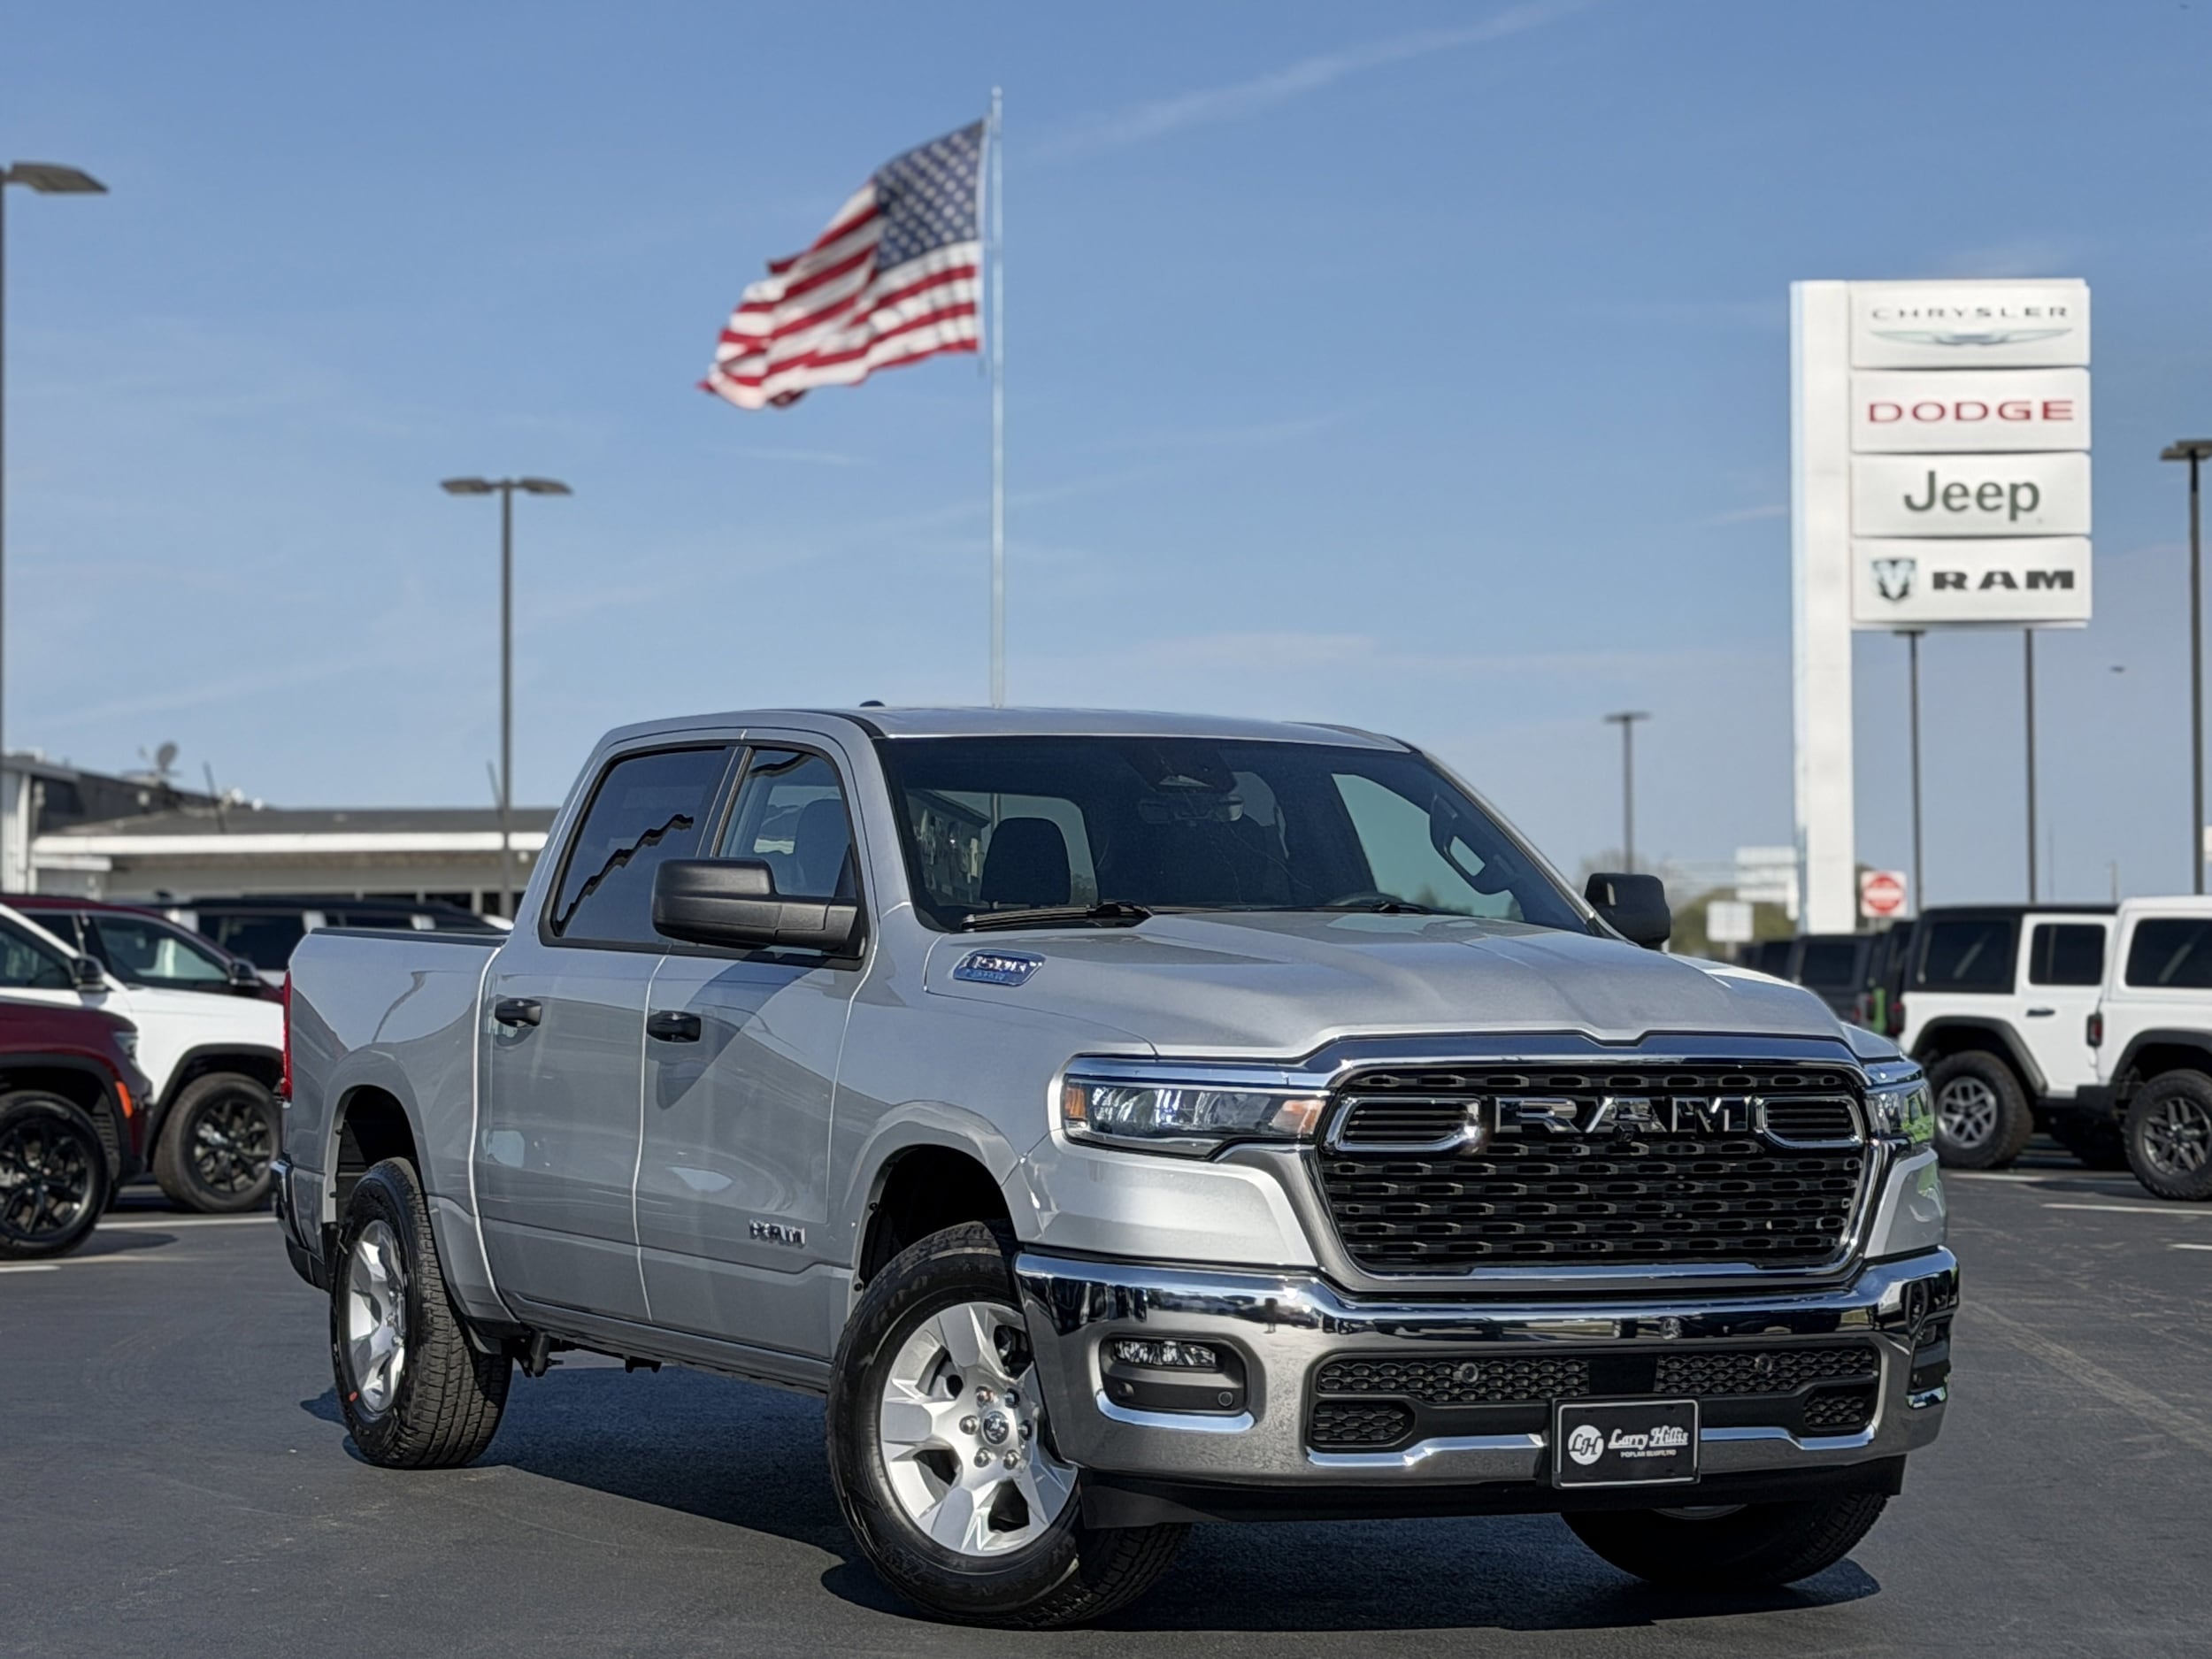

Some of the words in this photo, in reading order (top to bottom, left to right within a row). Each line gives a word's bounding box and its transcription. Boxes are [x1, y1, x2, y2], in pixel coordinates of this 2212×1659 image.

[1871, 305, 2068, 320] CHRYSLER
[1869, 400, 2074, 423] DODGE
[1903, 470, 2040, 522] Jeep
[1932, 570, 2075, 591] RAM
[1494, 1096, 1749, 1133] RAM
[749, 1219, 806, 1248] RAM
[1608, 1428, 1648, 1450] Larry
